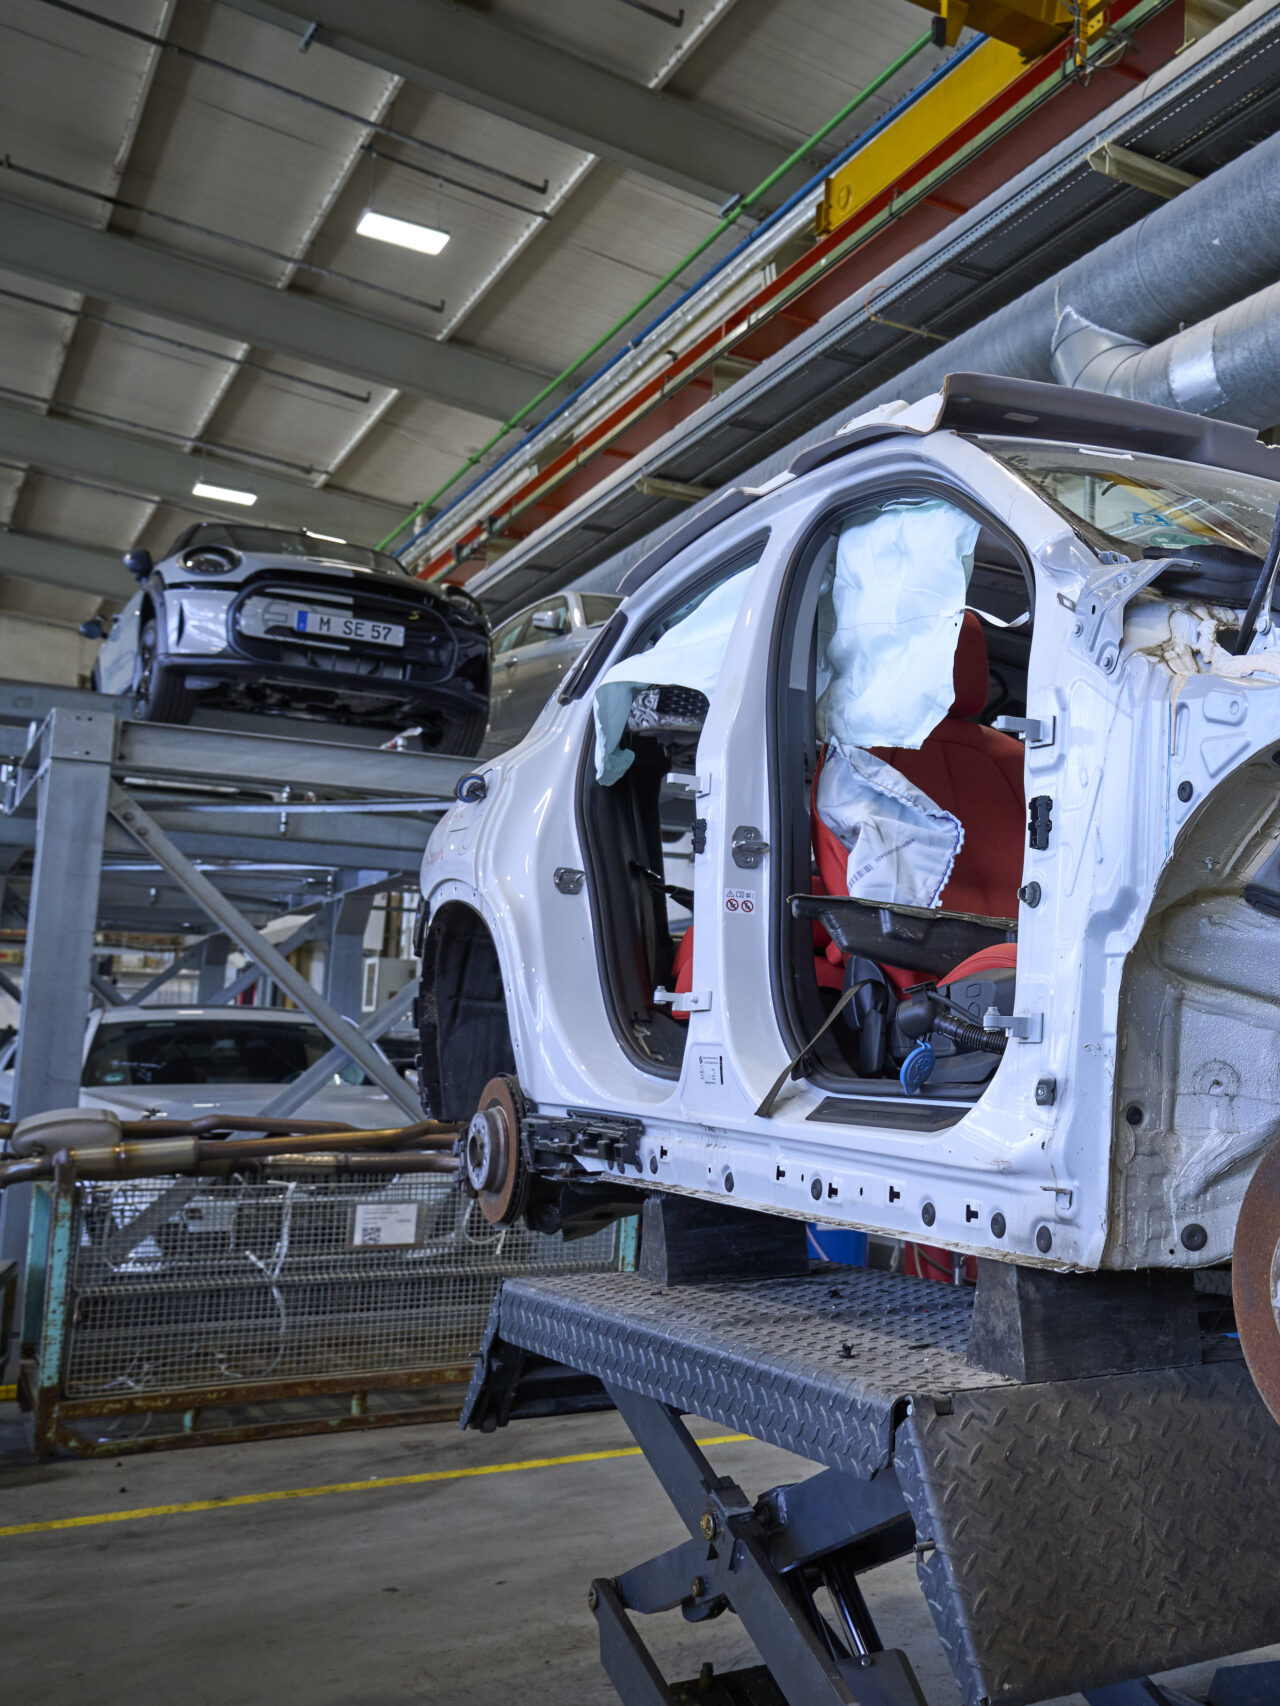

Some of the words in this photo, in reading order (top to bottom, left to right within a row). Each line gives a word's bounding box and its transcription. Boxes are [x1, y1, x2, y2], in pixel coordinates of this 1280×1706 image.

[319, 616, 331, 632] M
[342, 620, 365, 637] SE
[371, 624, 392, 640] 57
